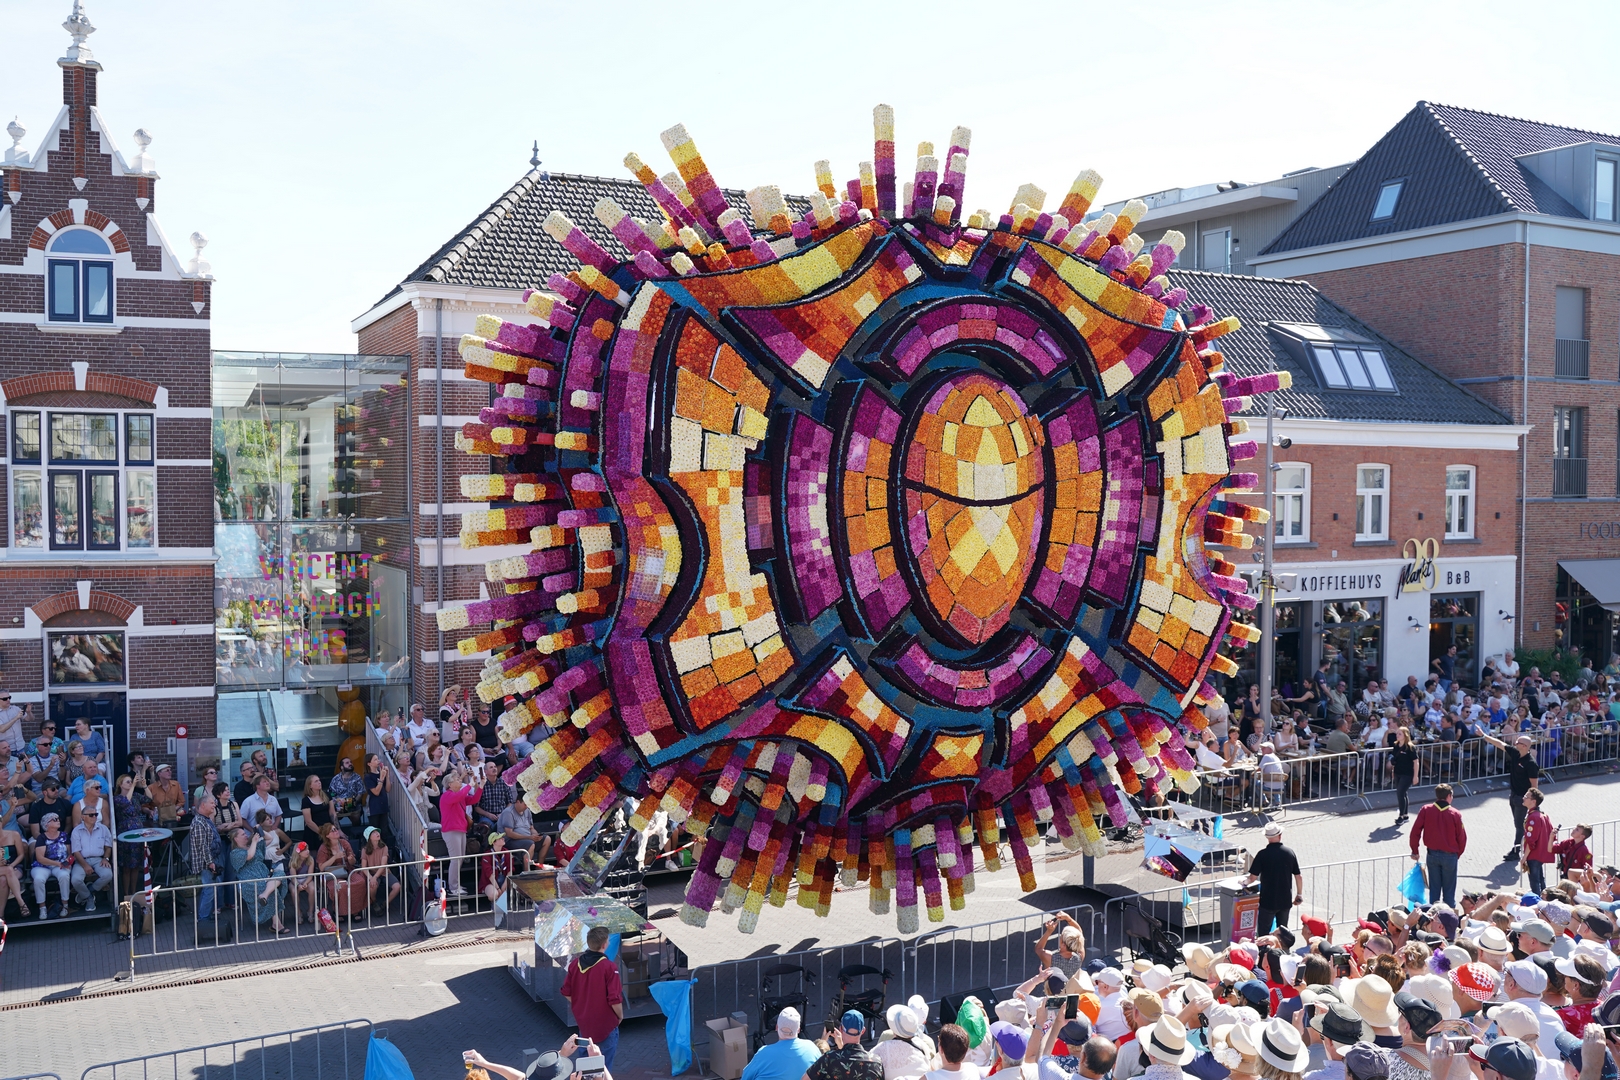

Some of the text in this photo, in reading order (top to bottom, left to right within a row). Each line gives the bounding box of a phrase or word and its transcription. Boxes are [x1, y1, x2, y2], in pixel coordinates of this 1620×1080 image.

[1581, 521, 1620, 539] FOOD
[258, 553, 371, 581] VINCENT
[1395, 558, 1433, 600] Markt
[1301, 574, 1382, 592] KOFFIEHUYS
[249, 591, 380, 620] VAN GOGH
[285, 629, 347, 657] HUIS
